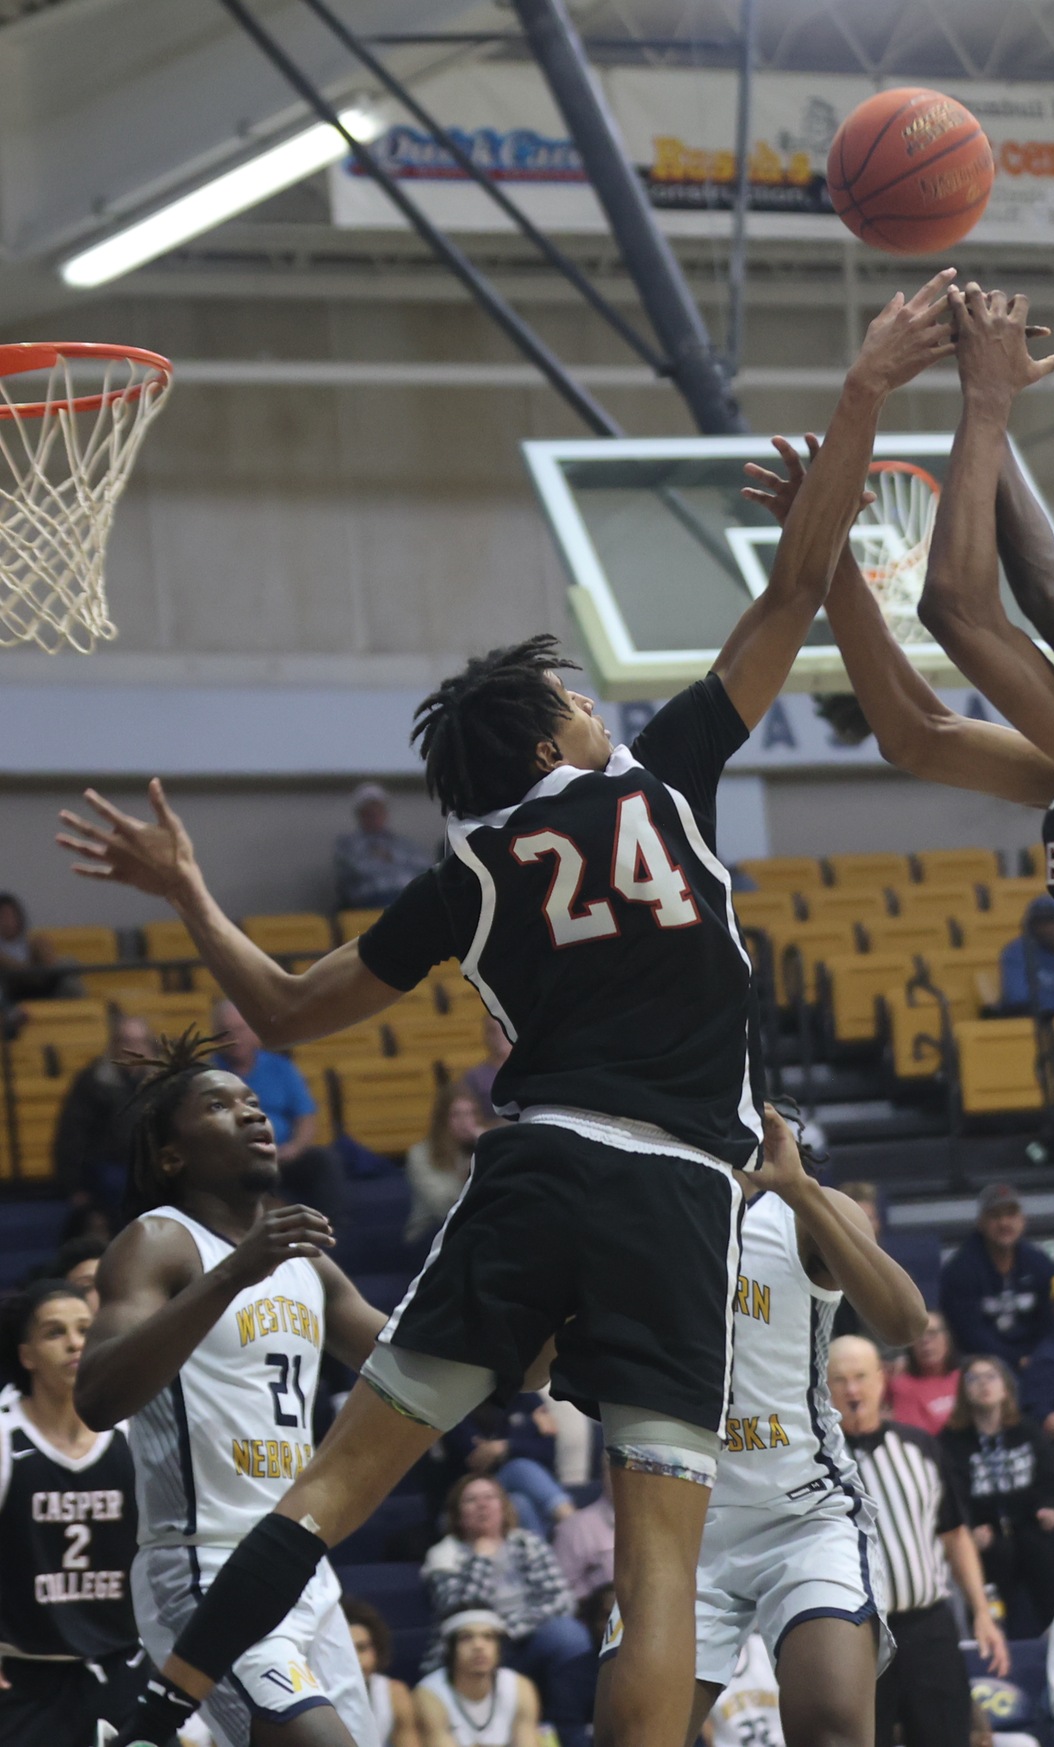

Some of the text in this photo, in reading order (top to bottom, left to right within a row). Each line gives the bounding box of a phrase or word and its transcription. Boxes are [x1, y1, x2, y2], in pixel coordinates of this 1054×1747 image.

[508, 789, 703, 951] 24
[235, 1295, 320, 1349] WESTERN
[264, 1352, 307, 1429] 21
[31, 1489, 124, 1522] CASPER
[62, 1523, 92, 1570] 2
[34, 1569, 125, 1604] COLLEGE
